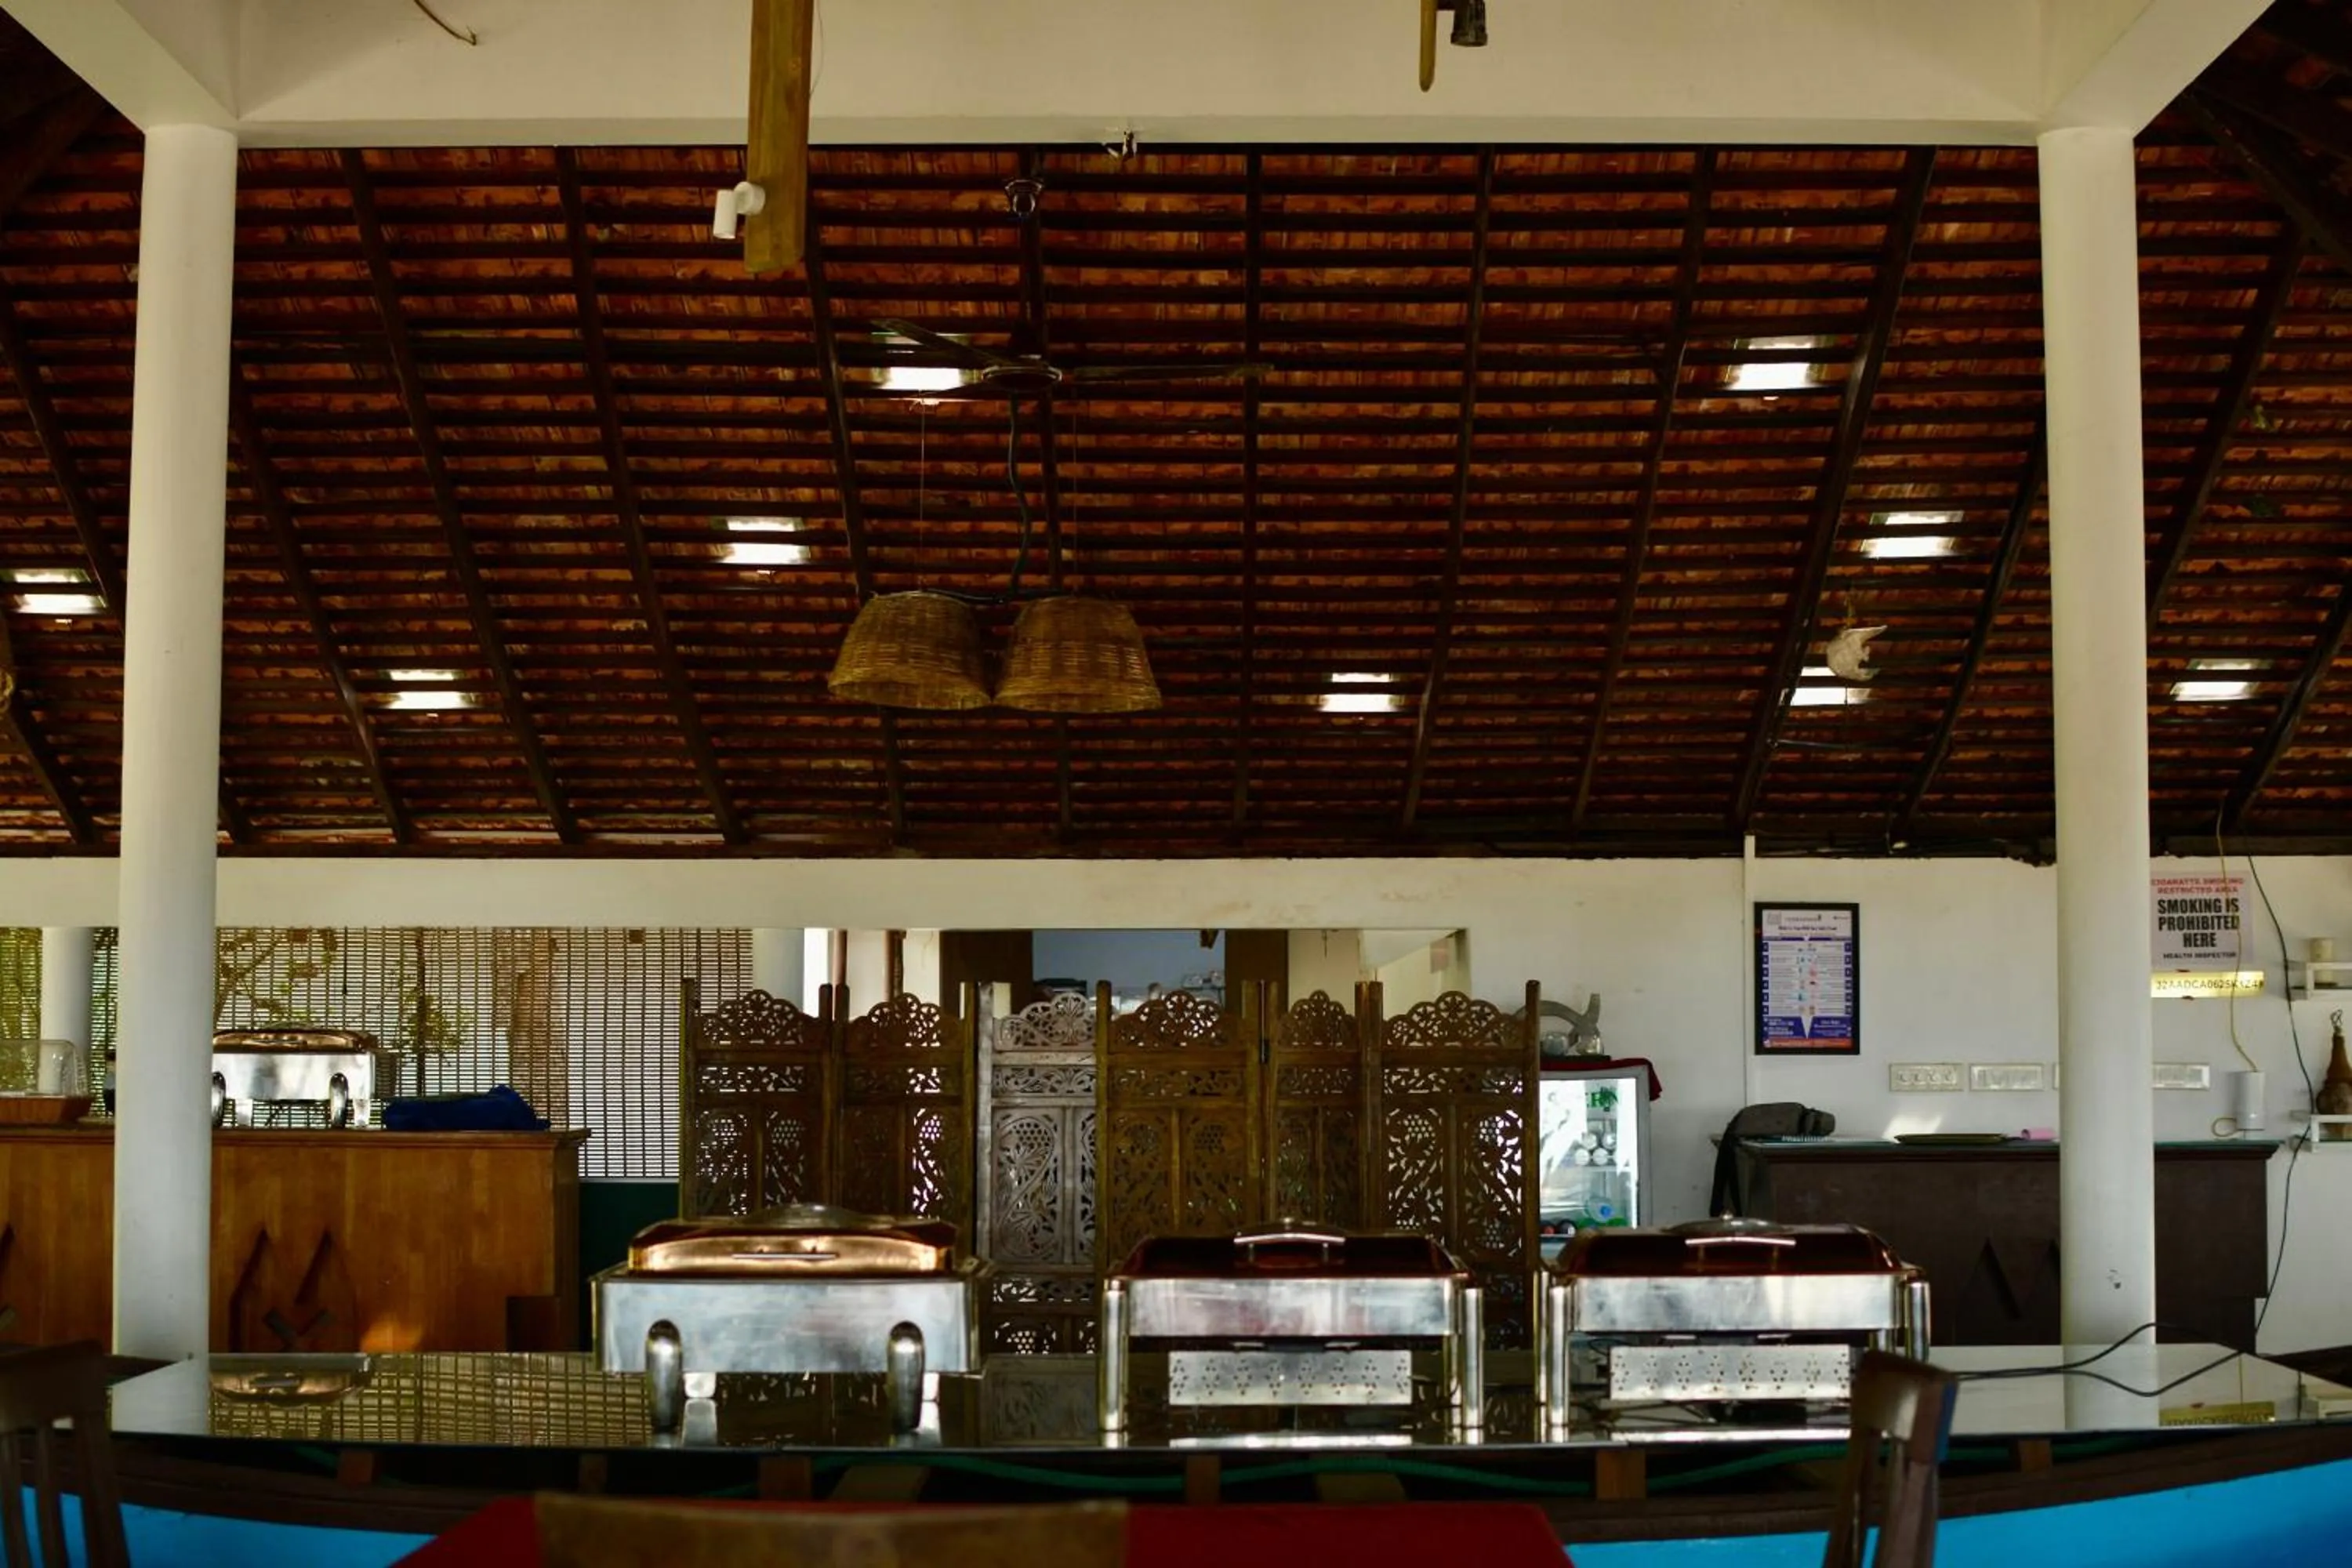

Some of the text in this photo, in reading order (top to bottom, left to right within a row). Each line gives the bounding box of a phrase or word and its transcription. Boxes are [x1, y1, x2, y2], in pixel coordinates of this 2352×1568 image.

[2158, 898, 2240, 914] SMOKING IS
[2158, 916, 2239, 931] PROHIBITED
[2183, 933, 2217, 948] HERE
